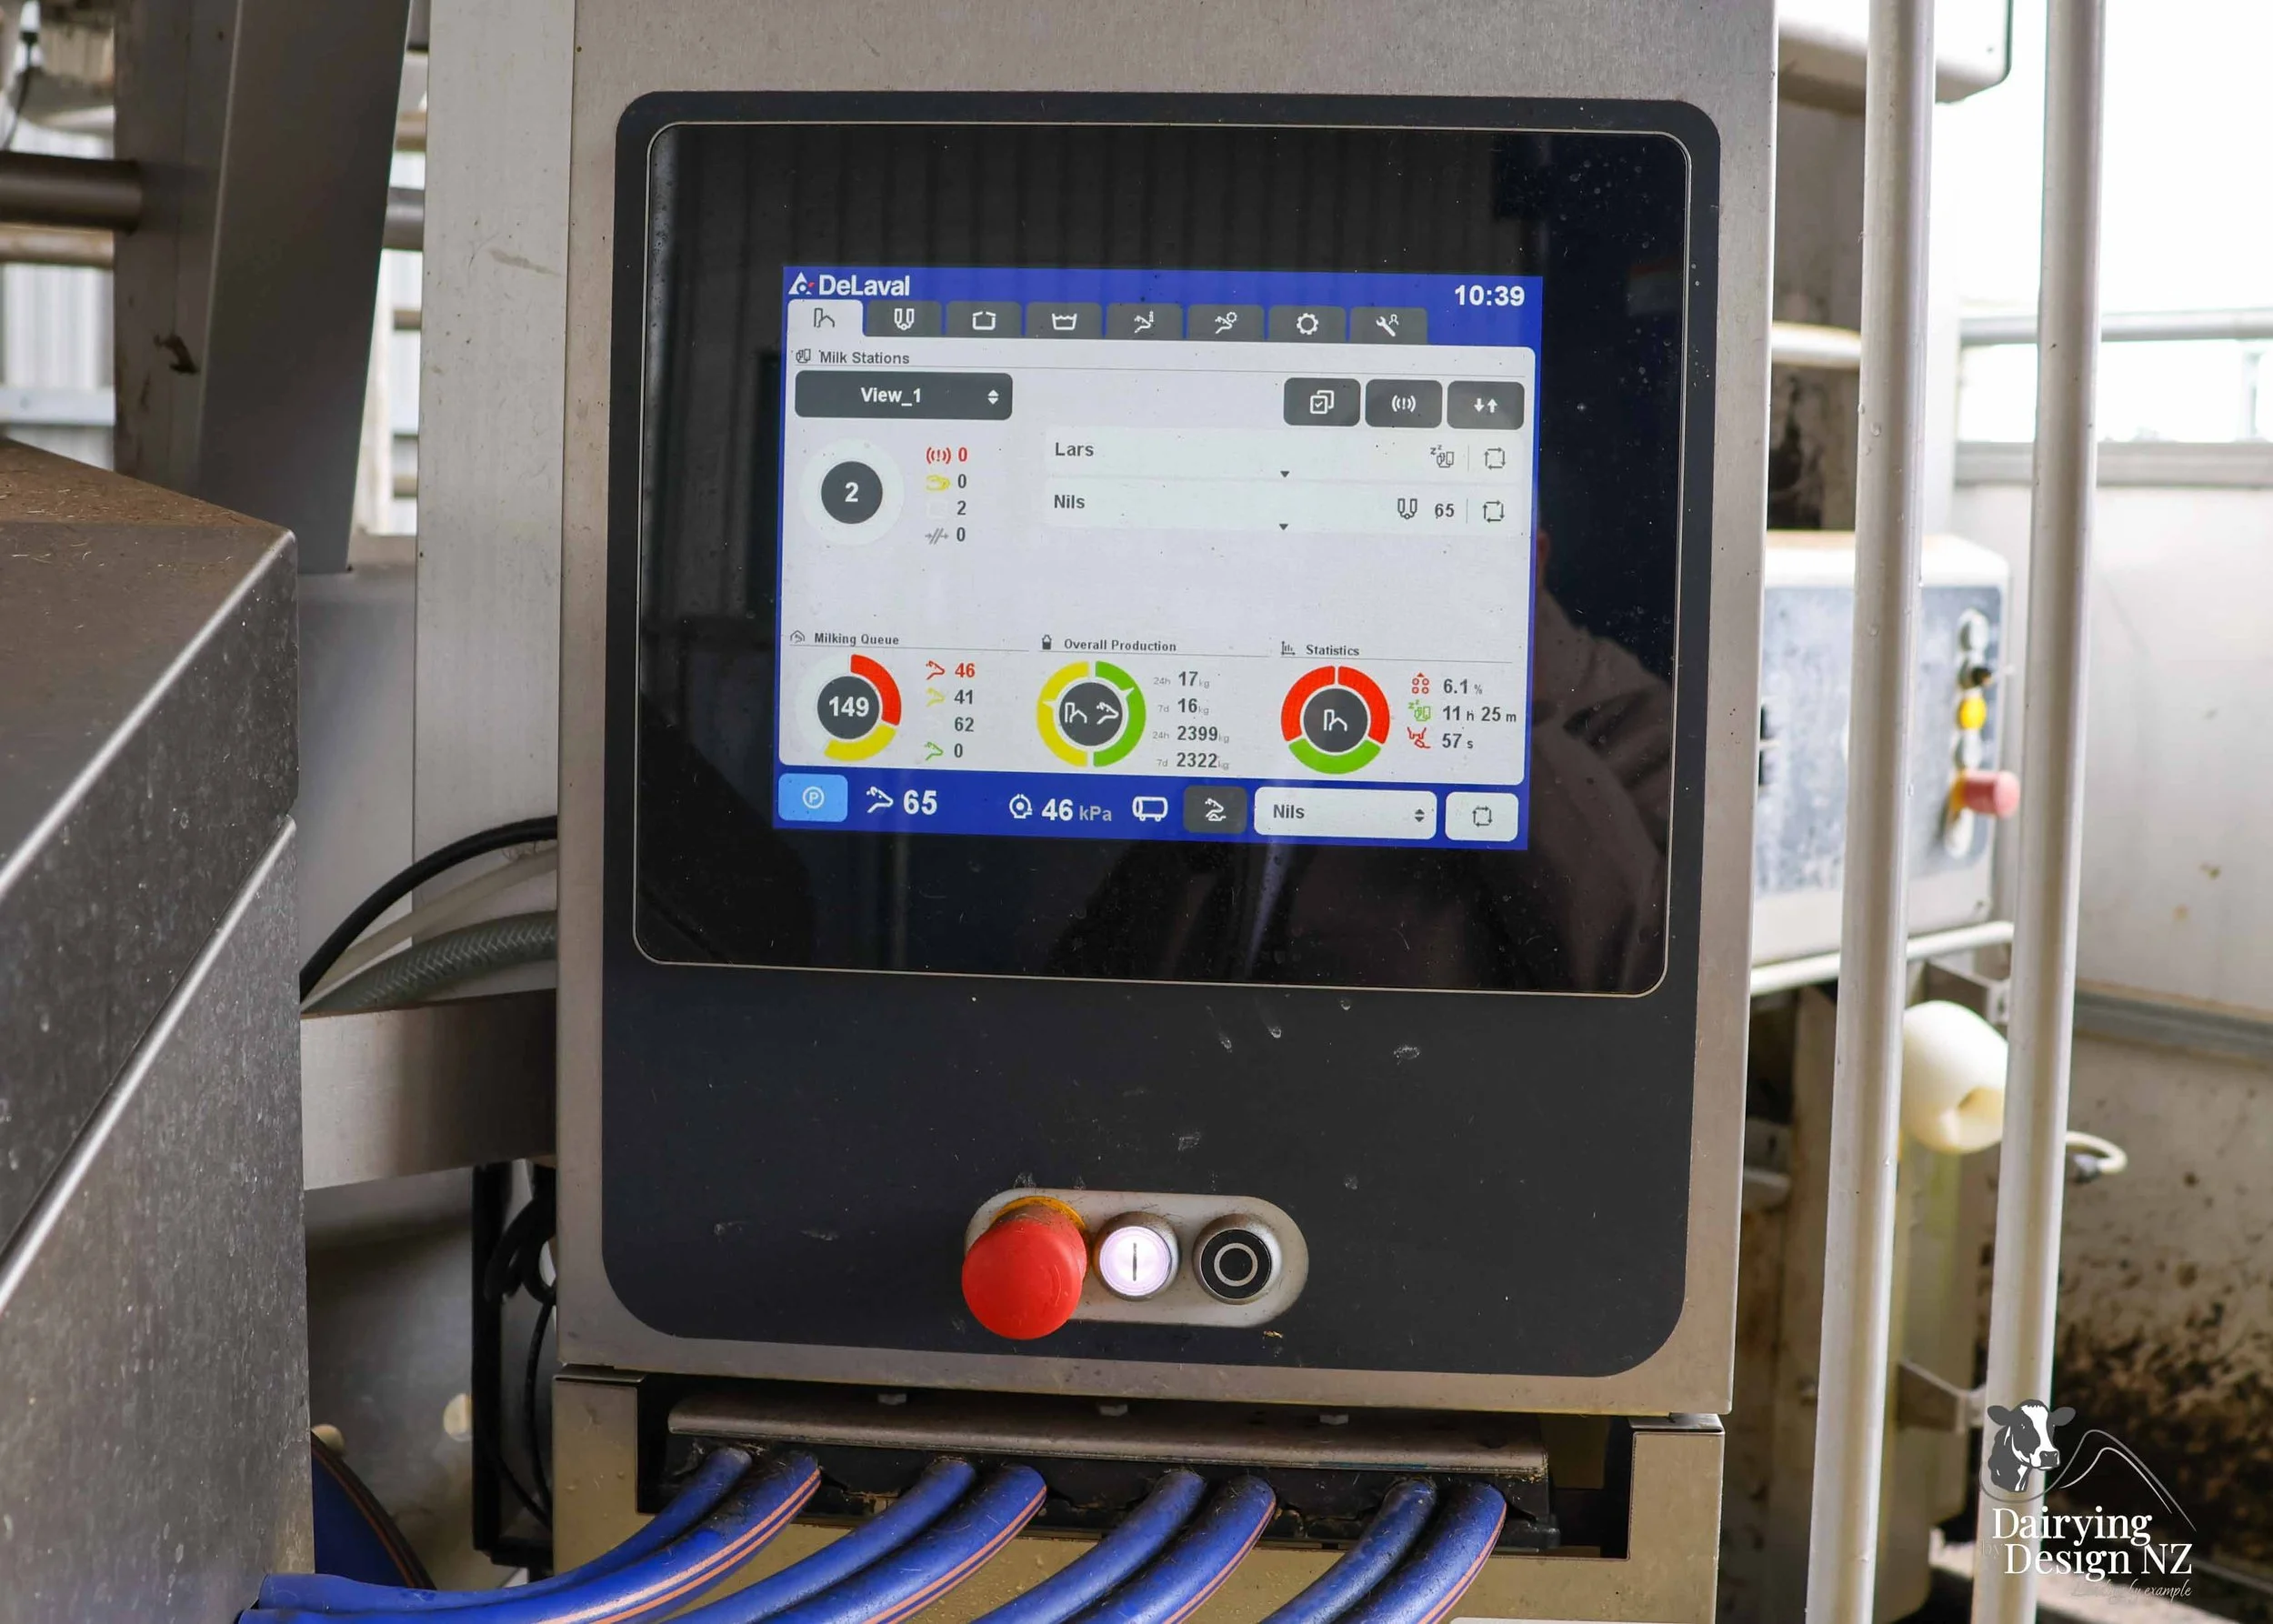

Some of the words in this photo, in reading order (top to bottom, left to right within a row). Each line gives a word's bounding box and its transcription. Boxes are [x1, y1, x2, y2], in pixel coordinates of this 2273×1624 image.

[819, 275, 910, 296] DeLaval
[1454, 285, 1526, 306] 10:39
[820, 350, 847, 365] Milk
[852, 352, 910, 365] Stations
[860, 386, 922, 407] View_1
[957, 447, 968, 463] 0
[1055, 442, 1094, 457] Lars
[957, 475, 967, 489] 0
[845, 481, 859, 503] 2
[956, 501, 966, 516] 2
[1054, 494, 1086, 509] Nils
[1435, 503, 1456, 518] 65
[956, 527, 966, 542] 0
[814, 632, 856, 647] Milking
[860, 634, 899, 647] Queue
[1064, 637, 1107, 651] Overall
[1111, 639, 1177, 653] Production
[1306, 644, 1359, 657] Statistics
[955, 662, 976, 678] 46
[1443, 678, 1468, 694] 6.1
[954, 689, 974, 705] 41
[828, 696, 869, 718] 149
[1442, 705, 1461, 721] 11
[1466, 711, 1475, 721] h
[1481, 707, 1502, 722] 25
[1505, 713, 1517, 723] m
[954, 717, 974, 732] 62
[1442, 733, 1463, 749] 57
[1467, 739, 1474, 749] s
[954, 743, 964, 758] 0
[808, 790, 819, 804] P
[903, 789, 937, 816] 65
[1041, 797, 1074, 822] 46
[1079, 804, 1112, 823] kPa
[1273, 804, 1306, 820] Nils
